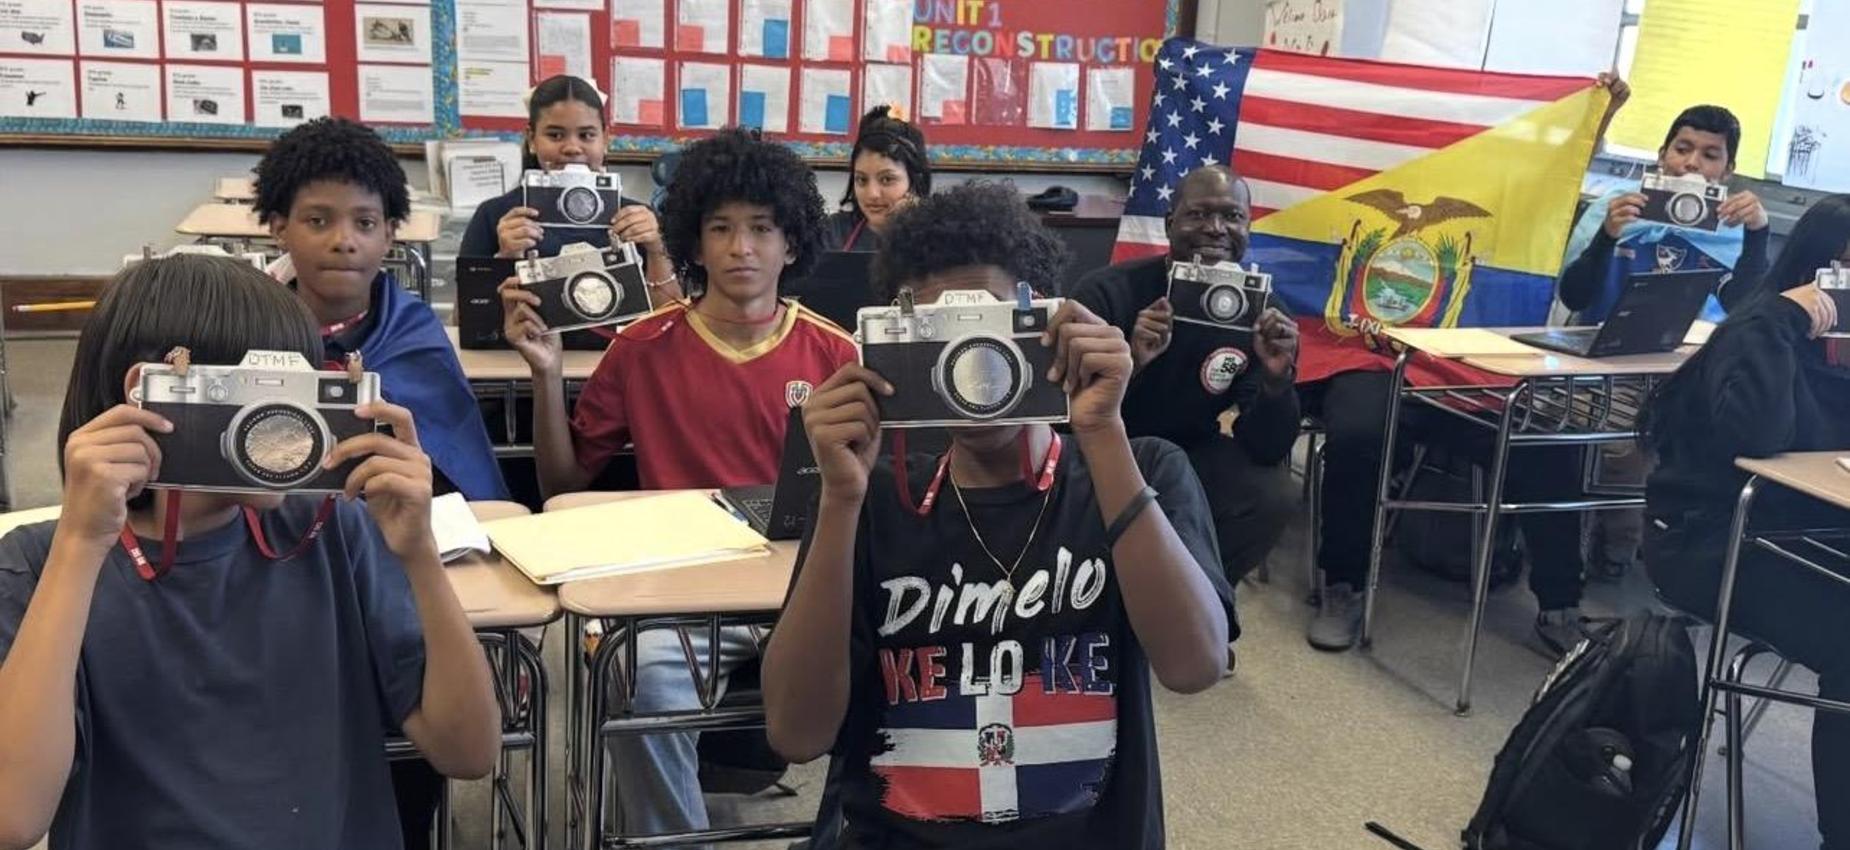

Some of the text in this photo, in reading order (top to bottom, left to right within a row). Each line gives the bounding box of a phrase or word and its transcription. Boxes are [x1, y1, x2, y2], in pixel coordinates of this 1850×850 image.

[913, 0, 1003, 27] UNIT 1
[912, 25, 1163, 62] RECONSTRUCTIO
[943, 291, 986, 305] DTMF
[248, 351, 301, 366] DTMF
[877, 546, 1106, 638] Dimelo
[878, 634, 1117, 706] KE LO KE
